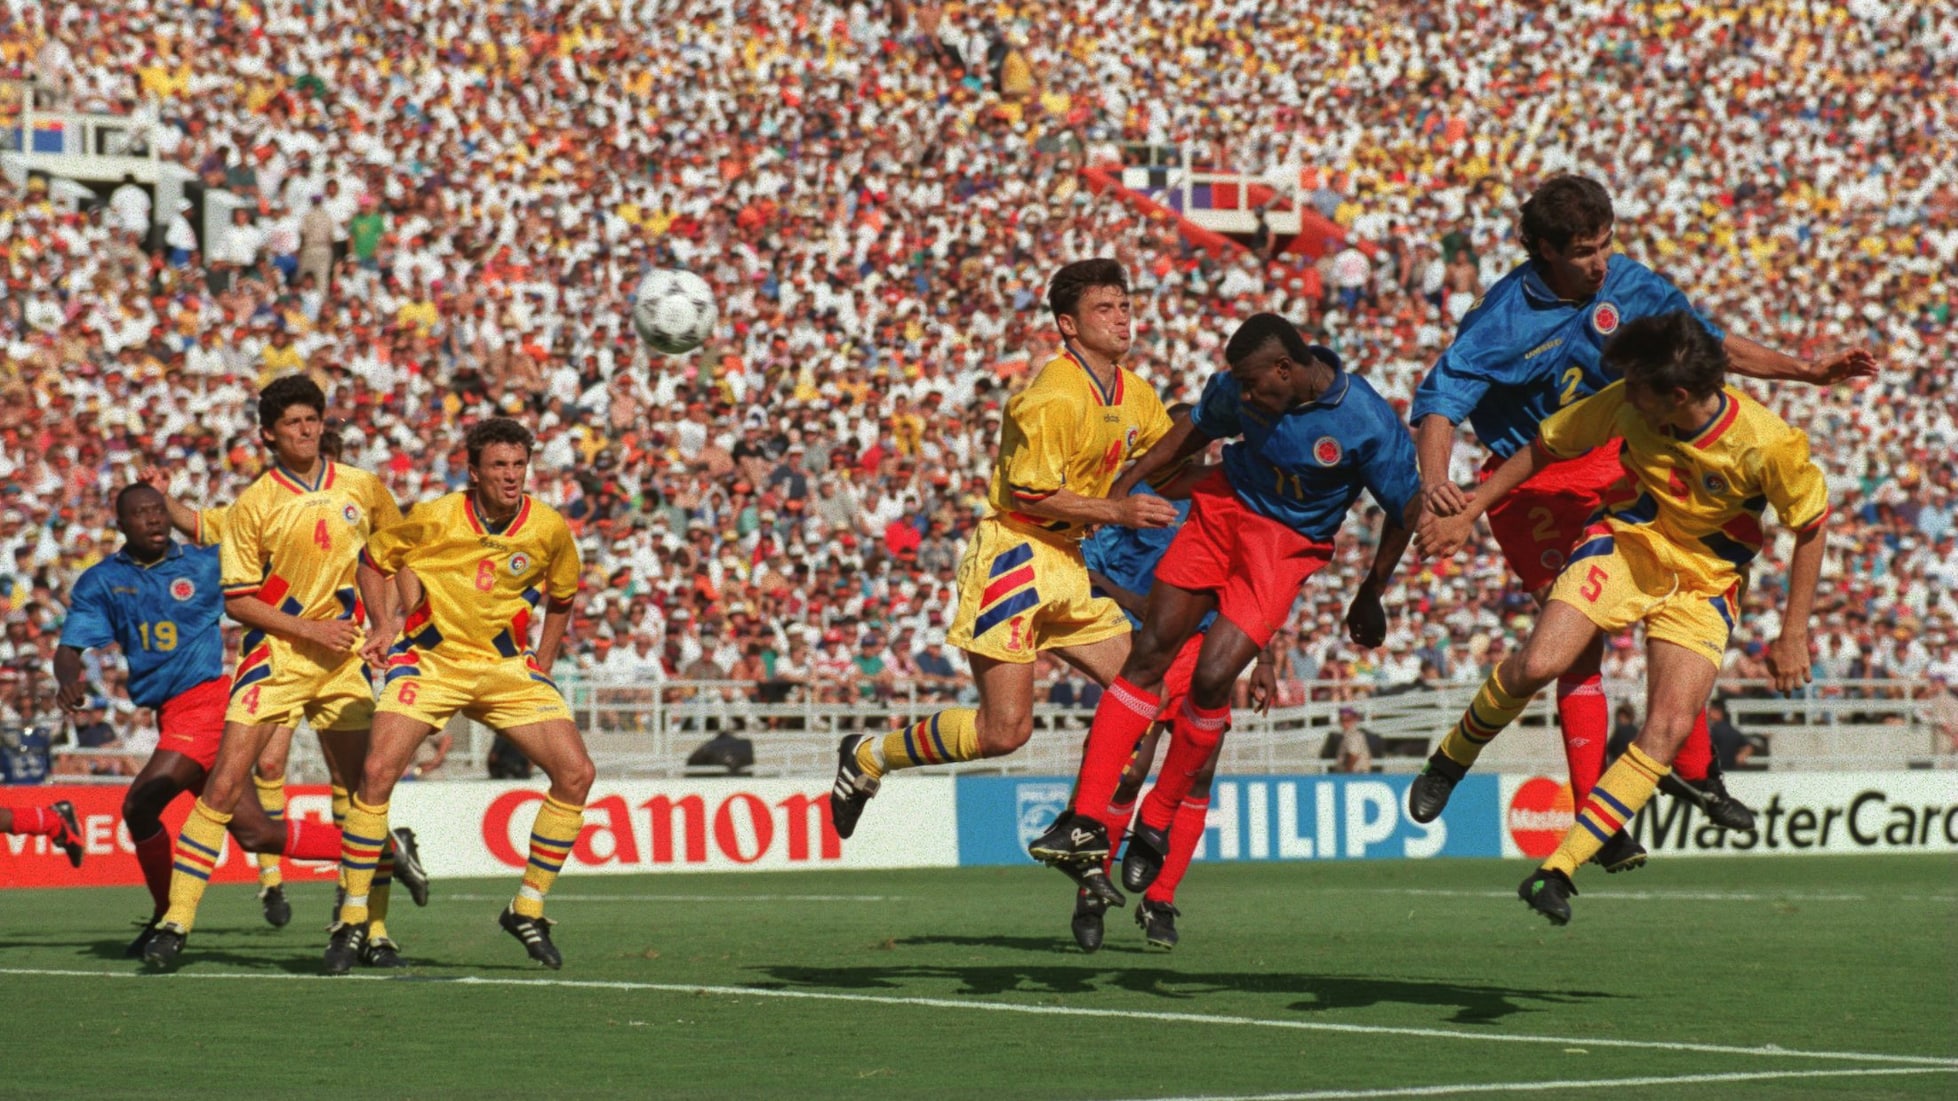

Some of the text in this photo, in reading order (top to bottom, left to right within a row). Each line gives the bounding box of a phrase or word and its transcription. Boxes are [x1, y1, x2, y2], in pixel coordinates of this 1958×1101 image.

[1560, 367, 1583, 406] 2
[314, 518, 332, 552] 4
[1528, 507, 1561, 542] 2
[475, 559, 497, 592] 6
[1580, 565, 1609, 603] 5
[139, 621, 178, 652] 19
[241, 684, 261, 715] 4
[398, 681, 420, 705] 6
[481, 789, 842, 868] Canon
[1128, 782, 1448, 859] HILIPS
